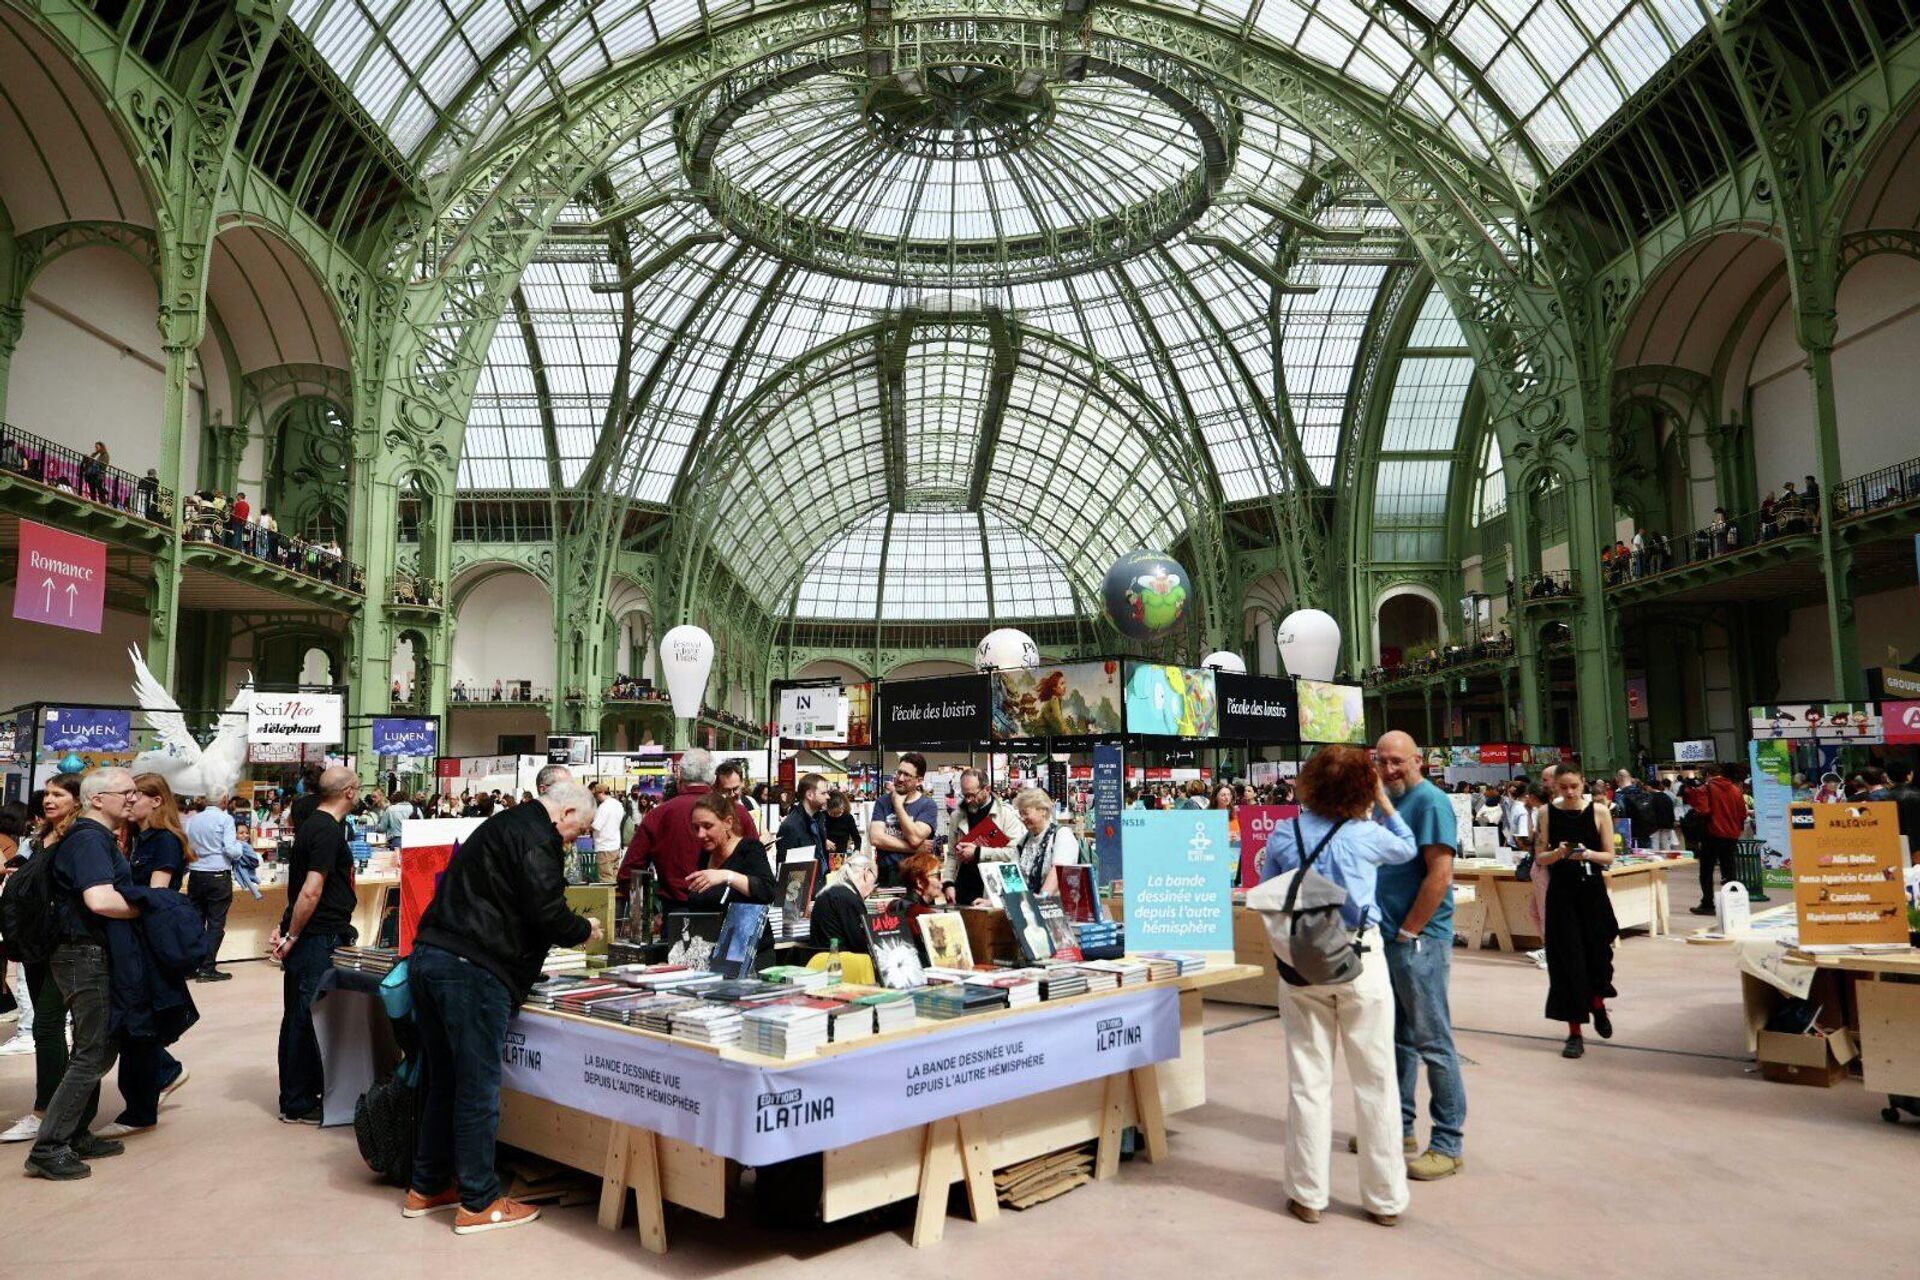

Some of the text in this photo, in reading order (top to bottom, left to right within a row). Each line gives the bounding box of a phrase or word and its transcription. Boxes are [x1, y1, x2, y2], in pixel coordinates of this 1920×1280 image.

[31, 550, 93, 581] Romance
[892, 700, 976, 721] l'école des loisirs
[1227, 697, 1287, 718] l'école des loisirs
[61, 724, 116, 735] LUMEN
[384, 732, 424, 741] LUMEN
[1251, 811, 1285, 831] ab
[1147, 873, 1206, 887] La bande
[1137, 888, 1217, 902] dessinée vue
[1134, 905, 1220, 921] depuis l'autre
[1143, 919, 1217, 937] hémisphère
[907, 1041, 1024, 1079] LA BANDE DESSINÉE VUE
[584, 1053, 680, 1089] LA BANDE DESSINÉE VUE
[584, 1071, 611, 1089] DEPUIS
[612, 1078, 645, 1099] L'AUTRE
[906, 1077, 944, 1098] DEPUIS
[945, 1067, 986, 1088] L'AUTRE
